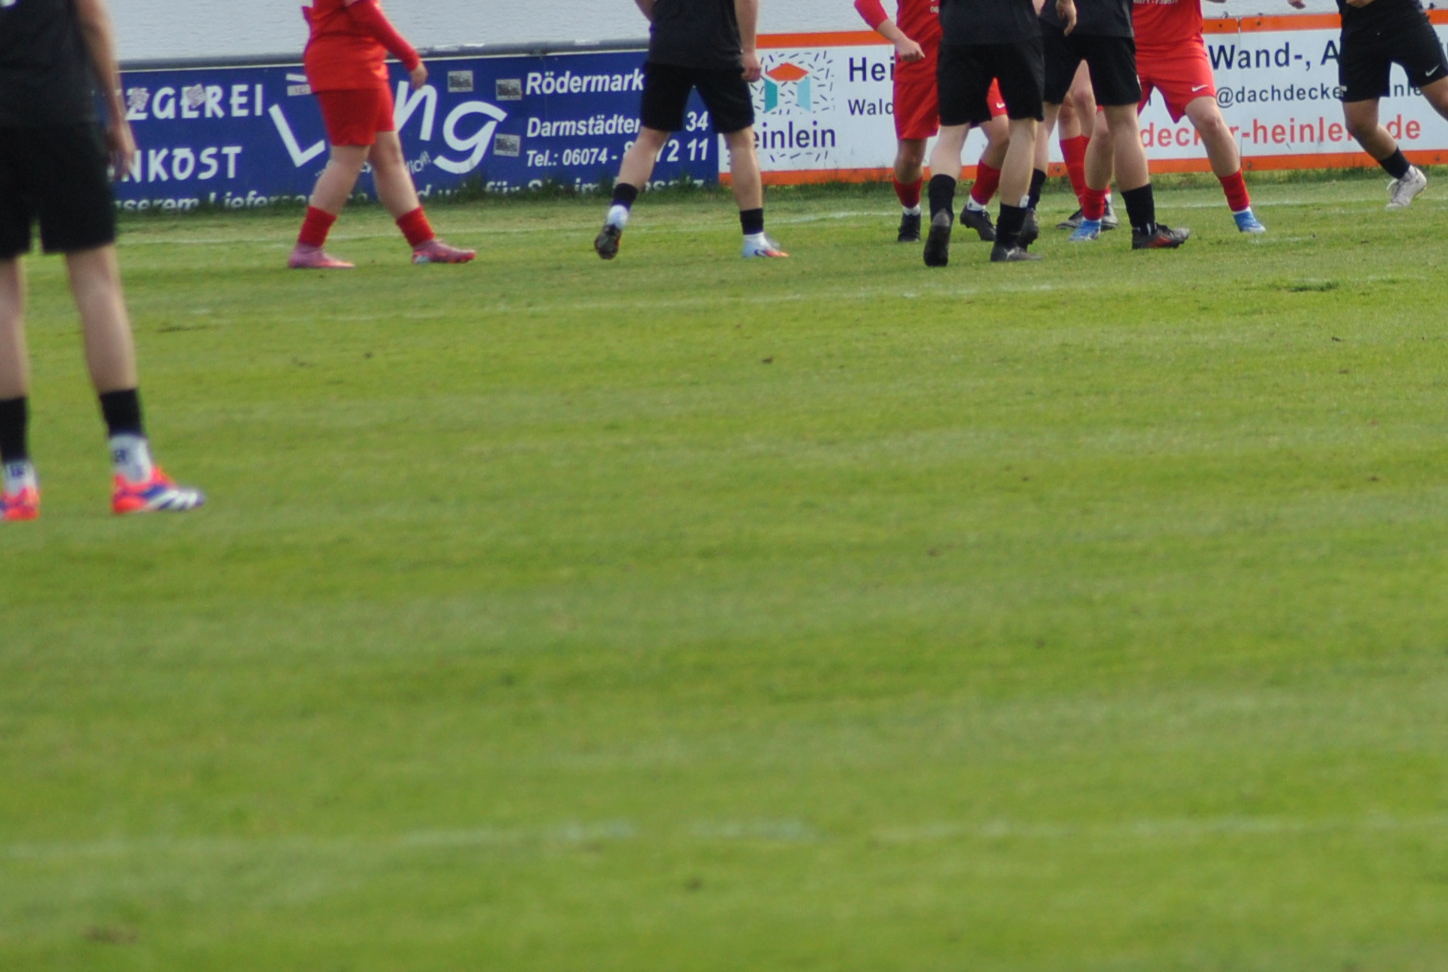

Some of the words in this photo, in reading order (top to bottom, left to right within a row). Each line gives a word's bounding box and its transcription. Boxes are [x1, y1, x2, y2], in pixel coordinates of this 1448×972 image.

[526, 68, 645, 95] Rödermark
[849, 57, 895, 82] Hei
[116, 84, 263, 120] ZGEREI
[267, 80, 508, 174] Lng
[685, 111, 709, 132] 34
[727, 121, 836, 150] einlein
[107, 146, 242, 183] NKOST
[526, 150, 558, 167] Tel.:
[562, 147, 608, 166] 06074
[687, 138, 709, 161] 11
